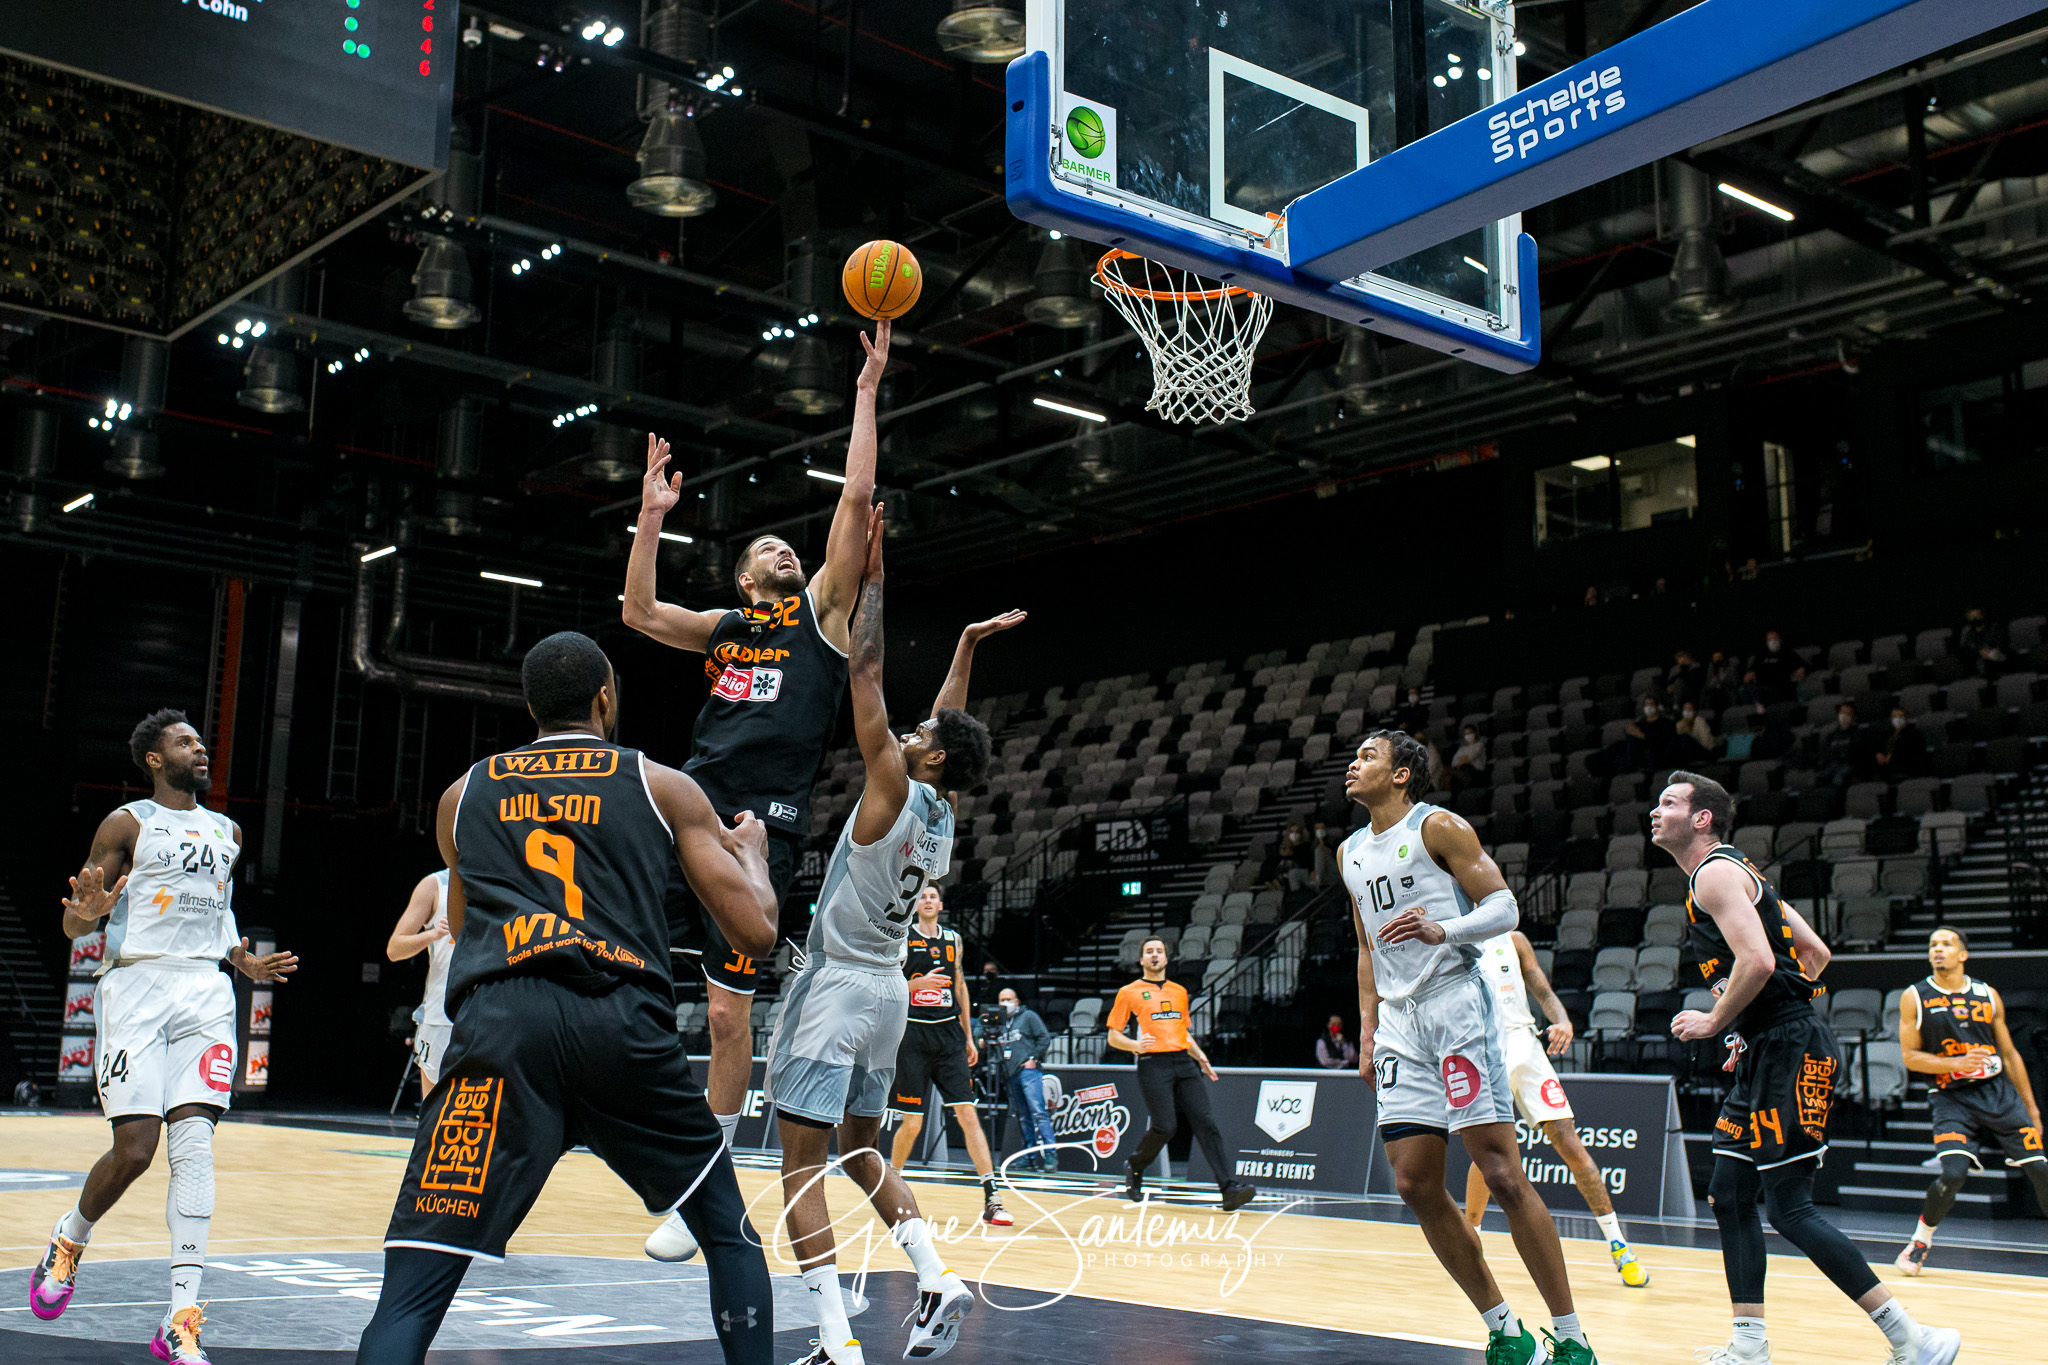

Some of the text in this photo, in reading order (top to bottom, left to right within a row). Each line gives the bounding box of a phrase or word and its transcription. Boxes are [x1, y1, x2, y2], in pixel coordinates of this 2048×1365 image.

[422, 16, 433, 32] 6
[421, 38, 432, 54] 4
[419, 60, 430, 76] 6
[1488, 66, 1622, 140] Schelde
[1492, 90, 1626, 163] Sports
[1062, 159, 1111, 183] BARMER
[869, 243, 894, 289] Wilson
[180, 842, 216, 875] 24
[525, 828, 585, 921] 9
[884, 865, 925, 923] 3
[1366, 875, 1395, 913] 10
[506, 949, 532, 966] Tools
[533, 941, 554, 954] that
[555, 936, 581, 948] work
[582, 939, 597, 952] for
[596, 944, 614, 962] you
[100, 1049, 128, 1088] 24
[1053, 1096, 1130, 1136] alcons
[1275, 1163, 1316, 1181] EVENTS
[1522, 1157, 1627, 1194] ürnrg
[415, 1194, 480, 1219] KÜCHEN
